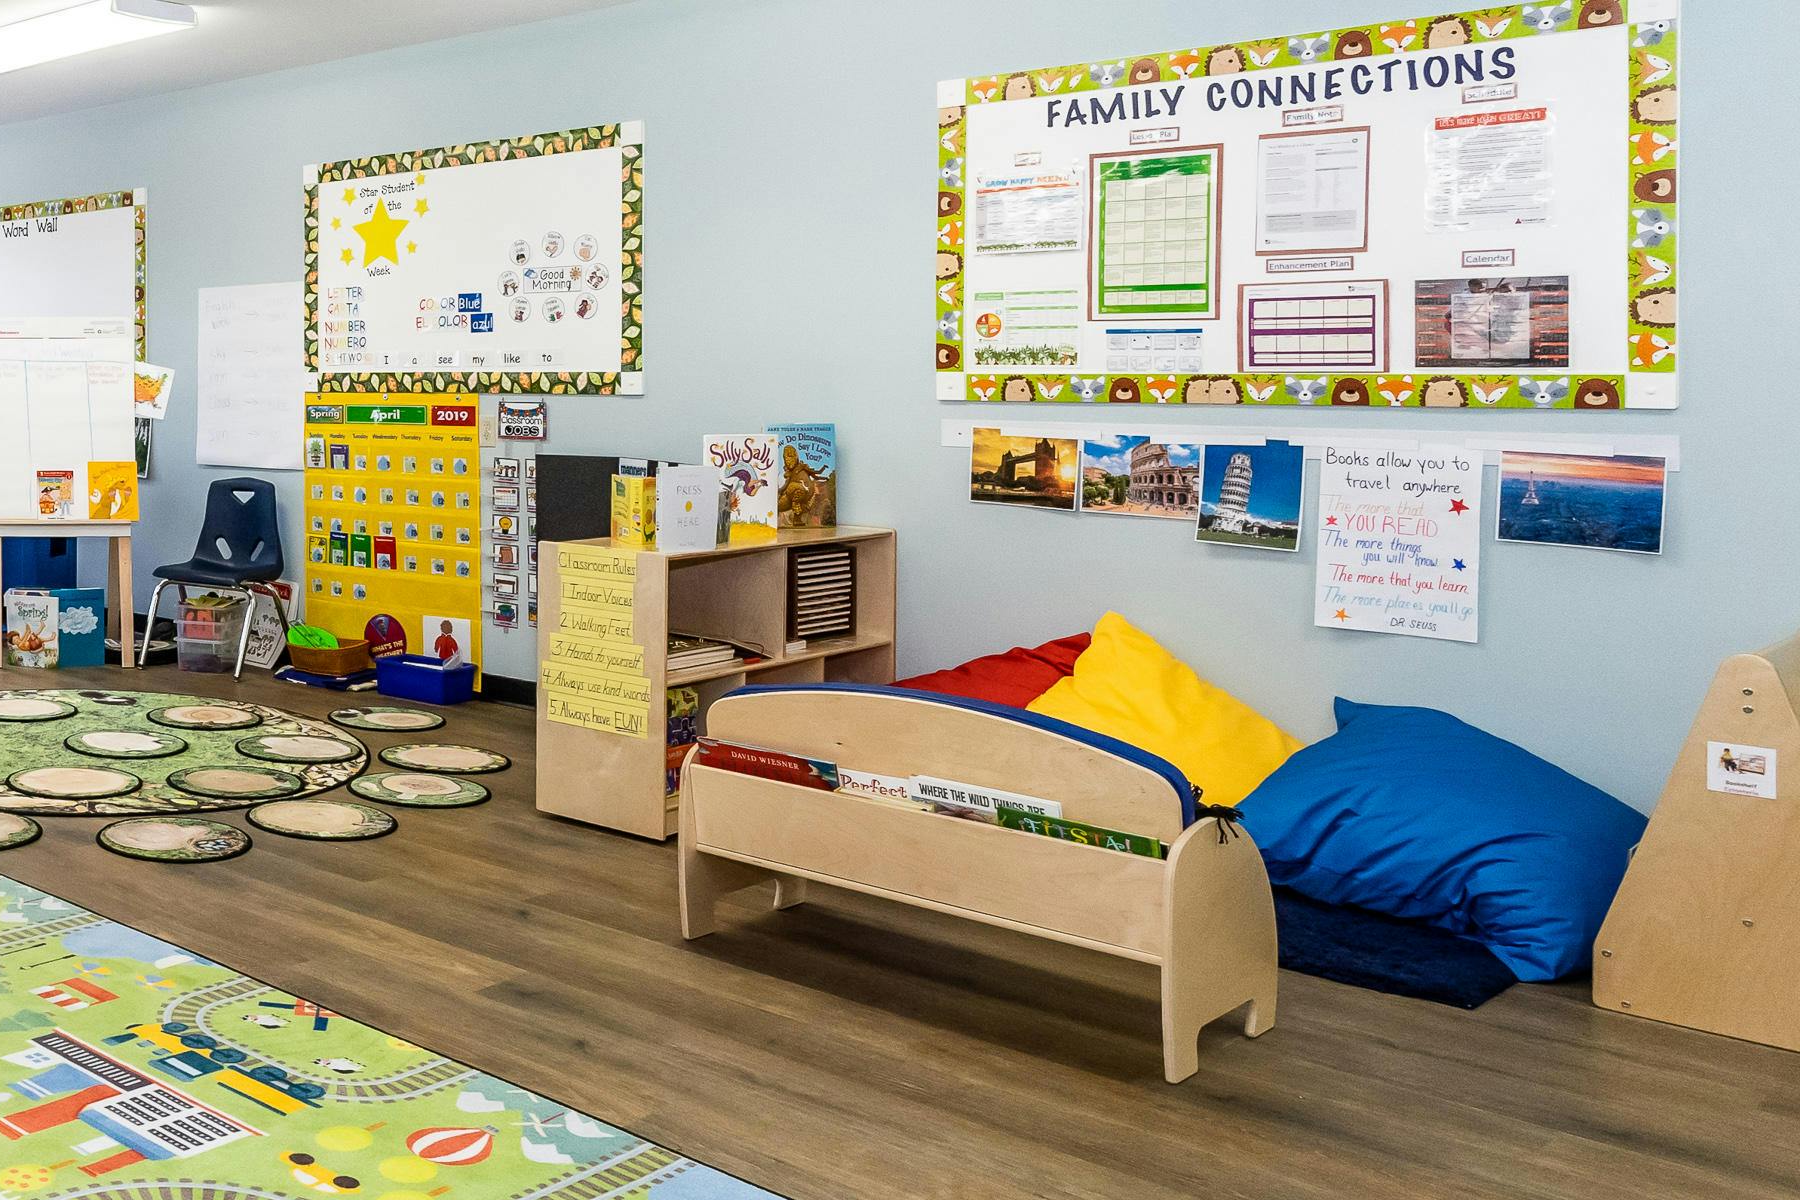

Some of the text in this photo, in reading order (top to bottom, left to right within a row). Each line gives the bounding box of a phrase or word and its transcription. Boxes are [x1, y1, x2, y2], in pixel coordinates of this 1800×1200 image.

[1047, 46, 1517, 128] FAMILY CONNECTIONS
[1286, 113, 1314, 121] Family
[360, 181, 416, 198] Star Student
[363, 200, 402, 215] of the
[2, 217, 58, 239] Word Wall
[1269, 259, 1350, 271] Enhancement Plan
[1465, 253, 1511, 264] Calendar
[367, 265, 391, 277] Week
[540, 268, 565, 280] Good
[532, 279, 573, 292] Morning
[384, 355, 389, 365] I
[411, 357, 418, 365] a
[437, 356, 454, 365] see
[472, 356, 486, 368] my
[503, 353, 521, 364] like
[541, 353, 553, 363] to
[310, 409, 340, 420] Spring
[370, 409, 400, 421] April
[437, 410, 469, 421] 2019
[501, 414, 543, 425] Classroom
[504, 426, 540, 436] JOBS
[785, 435, 797, 443] Do
[798, 433, 832, 447] Dinosaurs
[709, 437, 774, 471] Silly Sally
[798, 443, 810, 451] Say
[816, 444, 831, 457] Love
[805, 452, 822, 462] You?
[1326, 446, 1470, 475] Books allow you to
[676, 485, 703, 496] PRESS
[1346, 471, 1461, 498] travel anywhere
[1320, 494, 1350, 513] The
[1395, 500, 1424, 516] that
[677, 516, 700, 527] HERE
[1344, 513, 1439, 538] YOU READ
[1320, 528, 1423, 558] The more things
[558, 551, 636, 576] Classroom Rules
[1361, 552, 1438, 567] you will know
[1328, 563, 1353, 582] The
[1356, 574, 1385, 585] more
[1390, 571, 1412, 588] that
[1412, 580, 1434, 595] you
[569, 583, 602, 602] Indoor
[602, 587, 633, 607] Voices
[1320, 585, 1346, 602] The
[1351, 596, 1382, 607] more
[1385, 597, 1424, 614] places
[1459, 606, 1474, 622] go
[17, 605, 49, 621] Spring!
[560, 612, 631, 639] 2 Walking Feet
[1409, 621, 1437, 632] SEUSS
[393, 640, 403, 648] THE
[551, 640, 563, 656] 3
[565, 643, 594, 661] Hands
[595, 647, 605, 663] to
[542, 668, 651, 703] 4 Always use kind words
[550, 699, 643, 732] 5 Always have FUN!
[731, 751, 800, 771] DAVID WIESNER
[839, 773, 908, 799] Perfect
[918, 783, 1046, 815] WHERE THE WILD THINGS ARE
